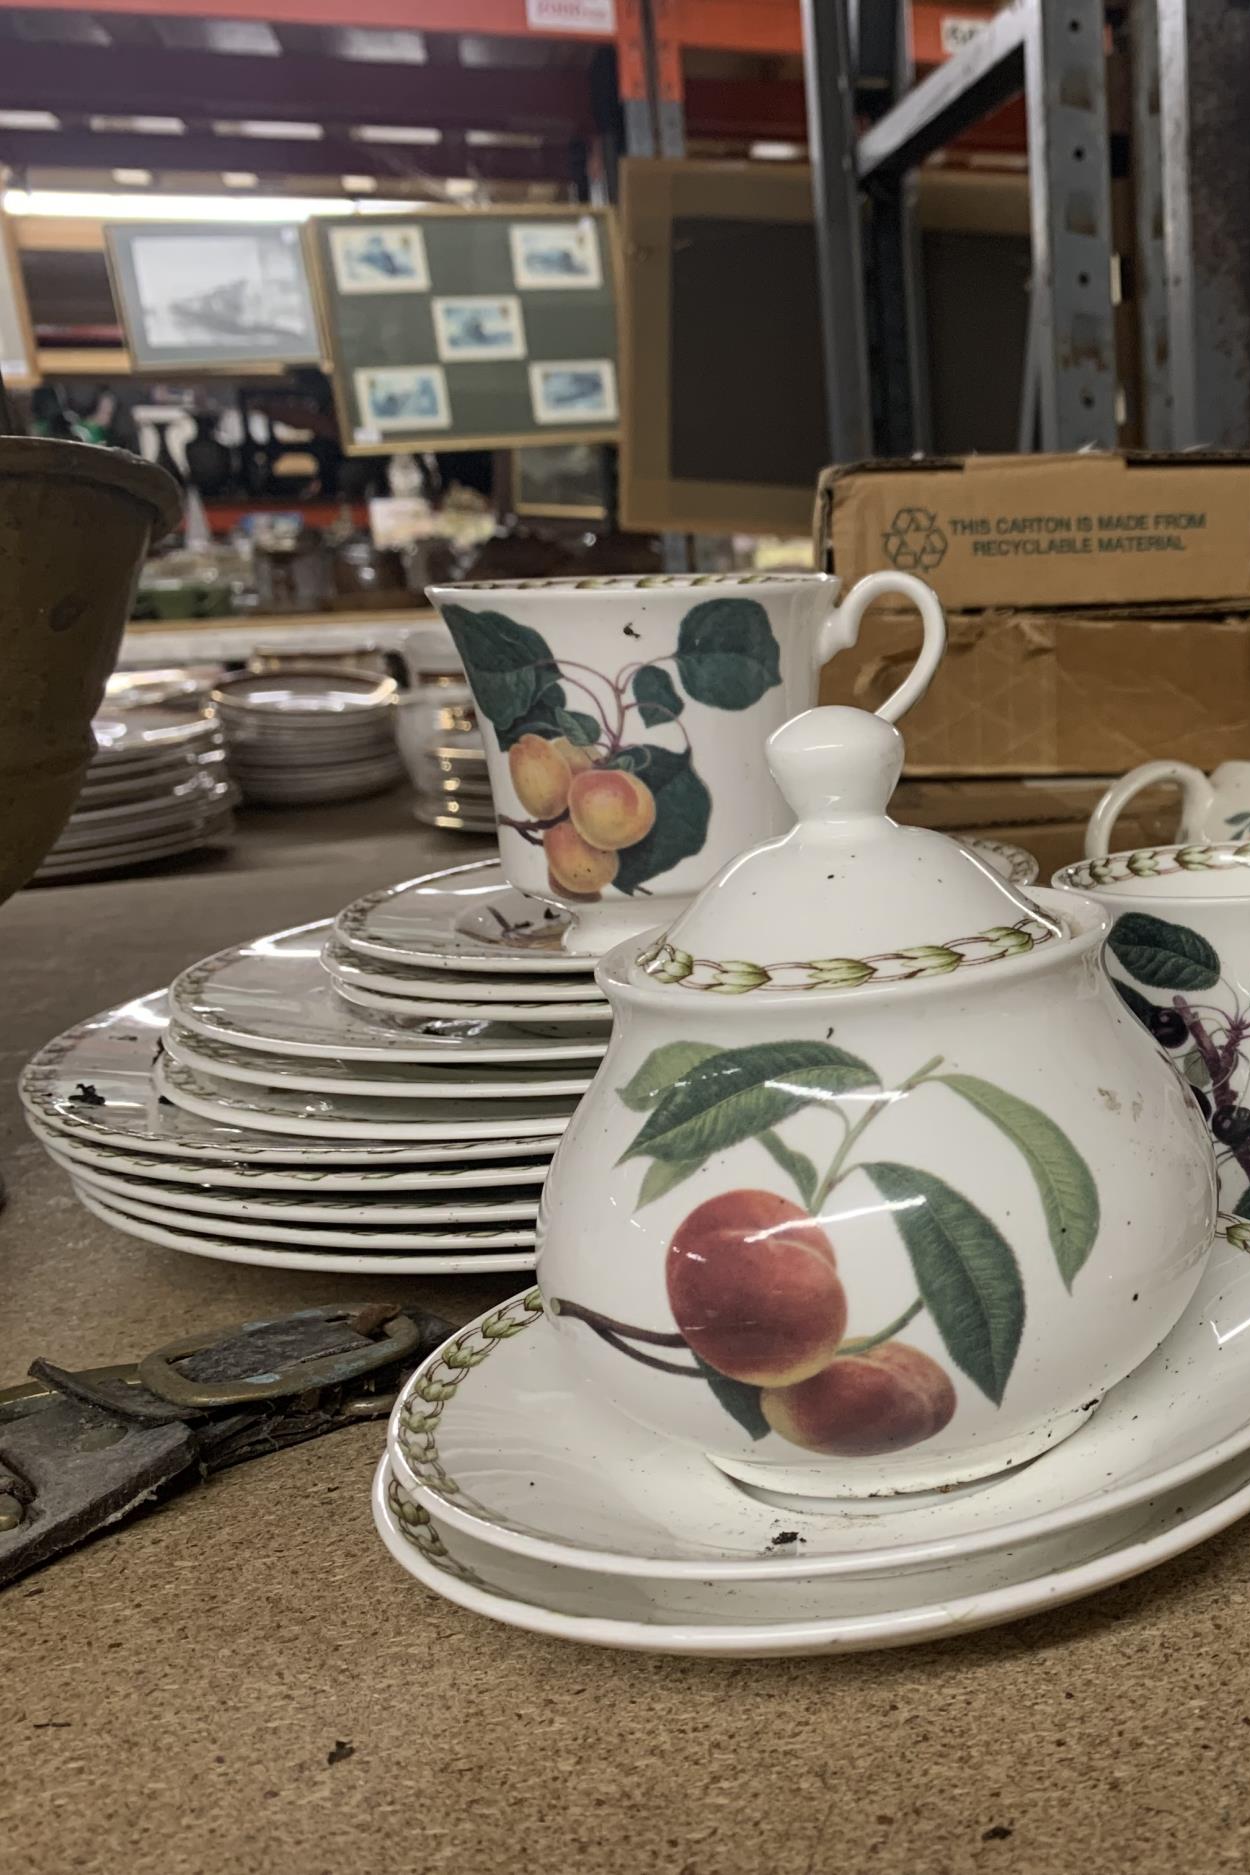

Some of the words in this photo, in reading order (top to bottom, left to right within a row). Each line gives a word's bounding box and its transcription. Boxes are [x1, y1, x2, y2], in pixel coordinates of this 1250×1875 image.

[948, 519, 991, 535] THIS
[995, 516, 1072, 534] CARTON
[1076, 515, 1093, 532] IS
[1099, 514, 1148, 531] MADE
[1153, 512, 1207, 530] FROM
[971, 538, 1093, 556] RECYCLABLE
[1098, 535, 1187, 552] MATERIAL
